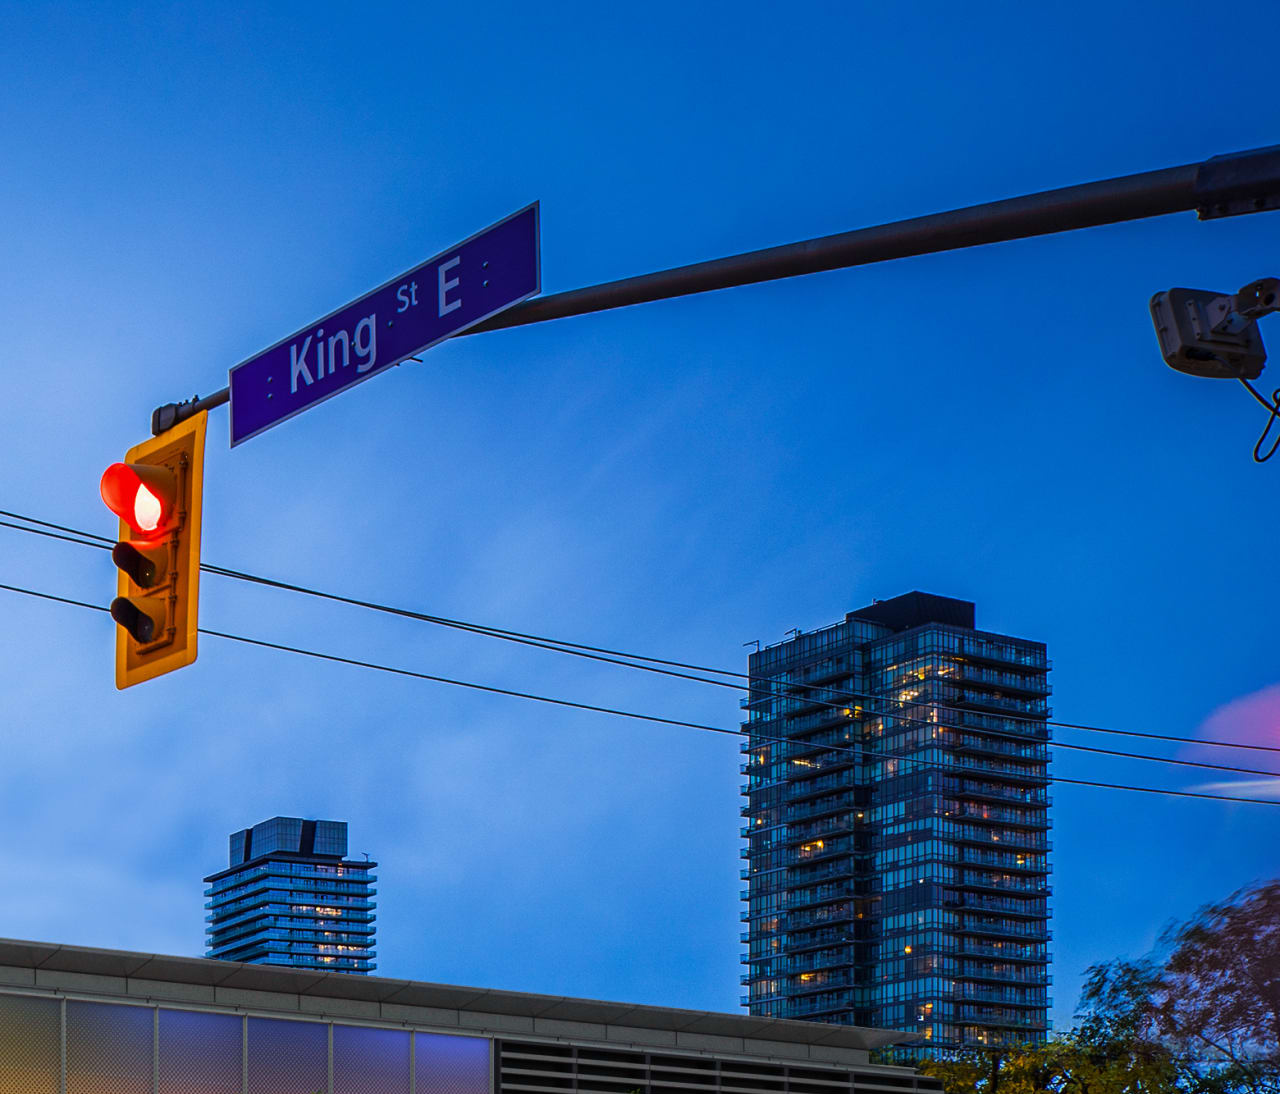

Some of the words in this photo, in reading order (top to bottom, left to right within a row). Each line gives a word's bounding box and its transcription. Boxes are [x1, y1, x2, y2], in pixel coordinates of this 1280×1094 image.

[289, 311, 378, 393] King
[397, 280, 418, 313] St
[437, 255, 462, 317] E
